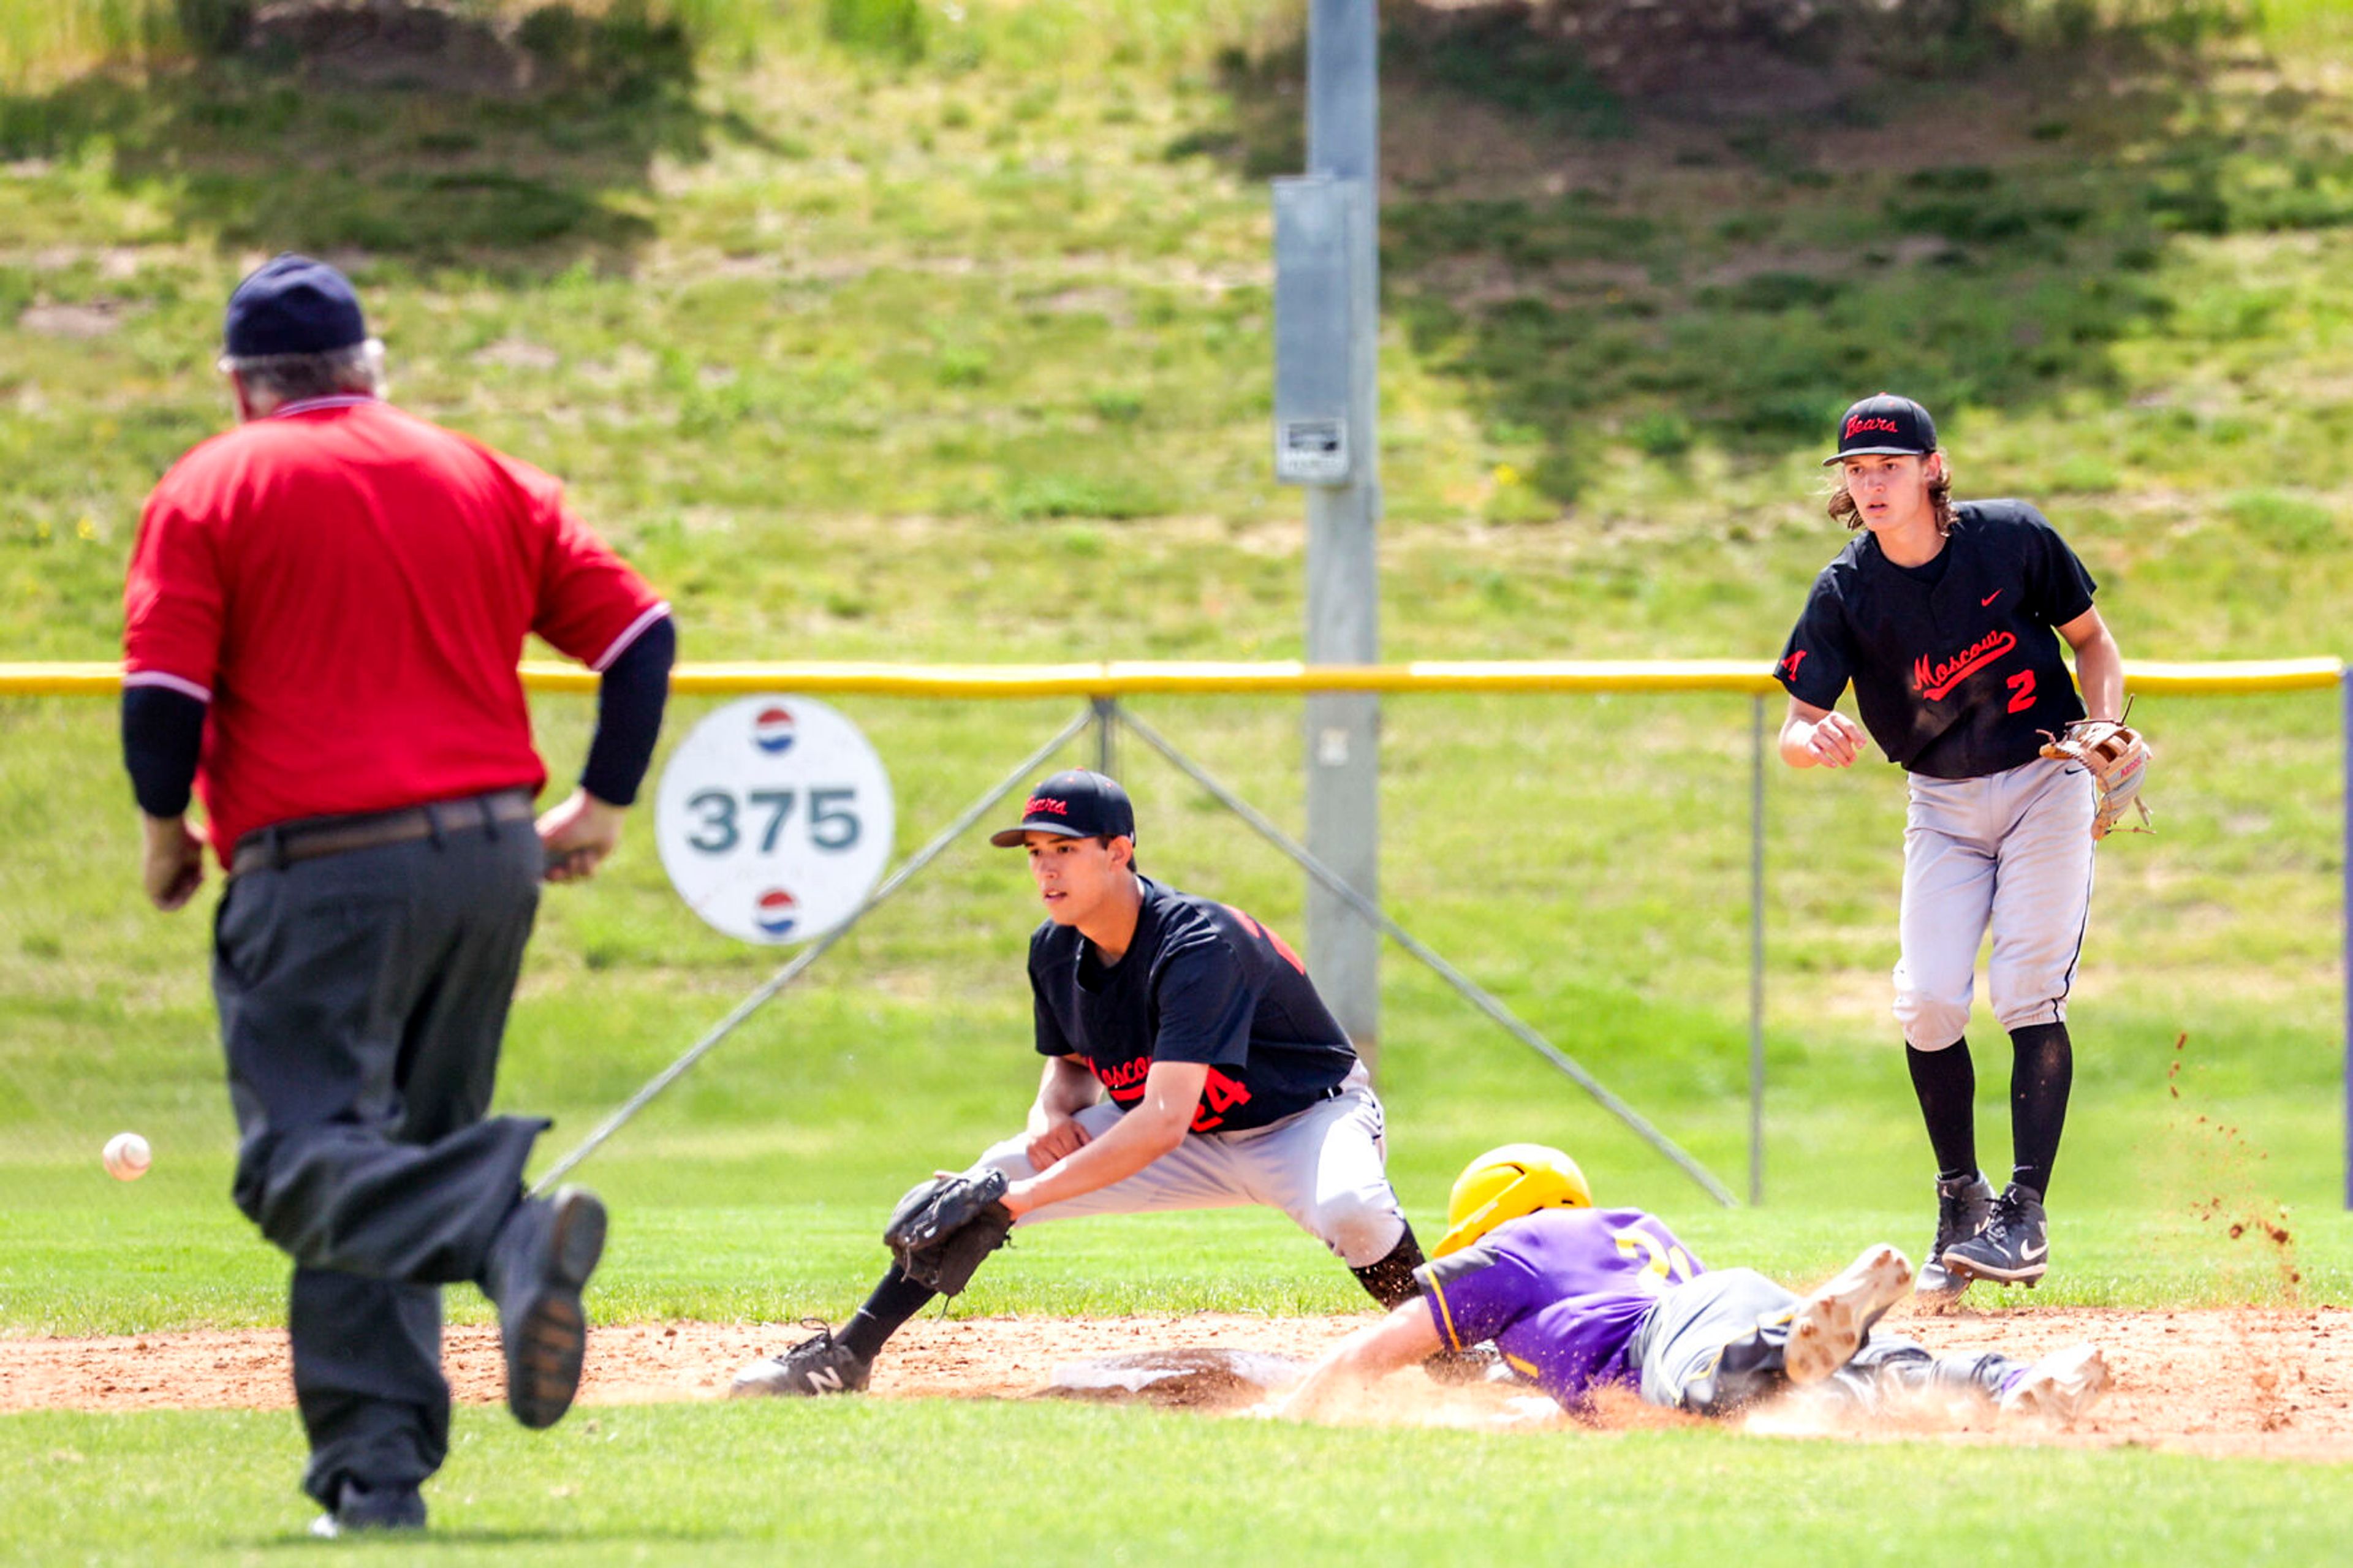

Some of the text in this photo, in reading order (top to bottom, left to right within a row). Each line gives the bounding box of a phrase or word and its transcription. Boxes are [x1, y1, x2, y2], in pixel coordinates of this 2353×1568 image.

[1844, 414, 1898, 440] Bears
[1913, 630, 2017, 697] Moscow
[2006, 669, 2037, 713] 2
[686, 786, 863, 854] 375
